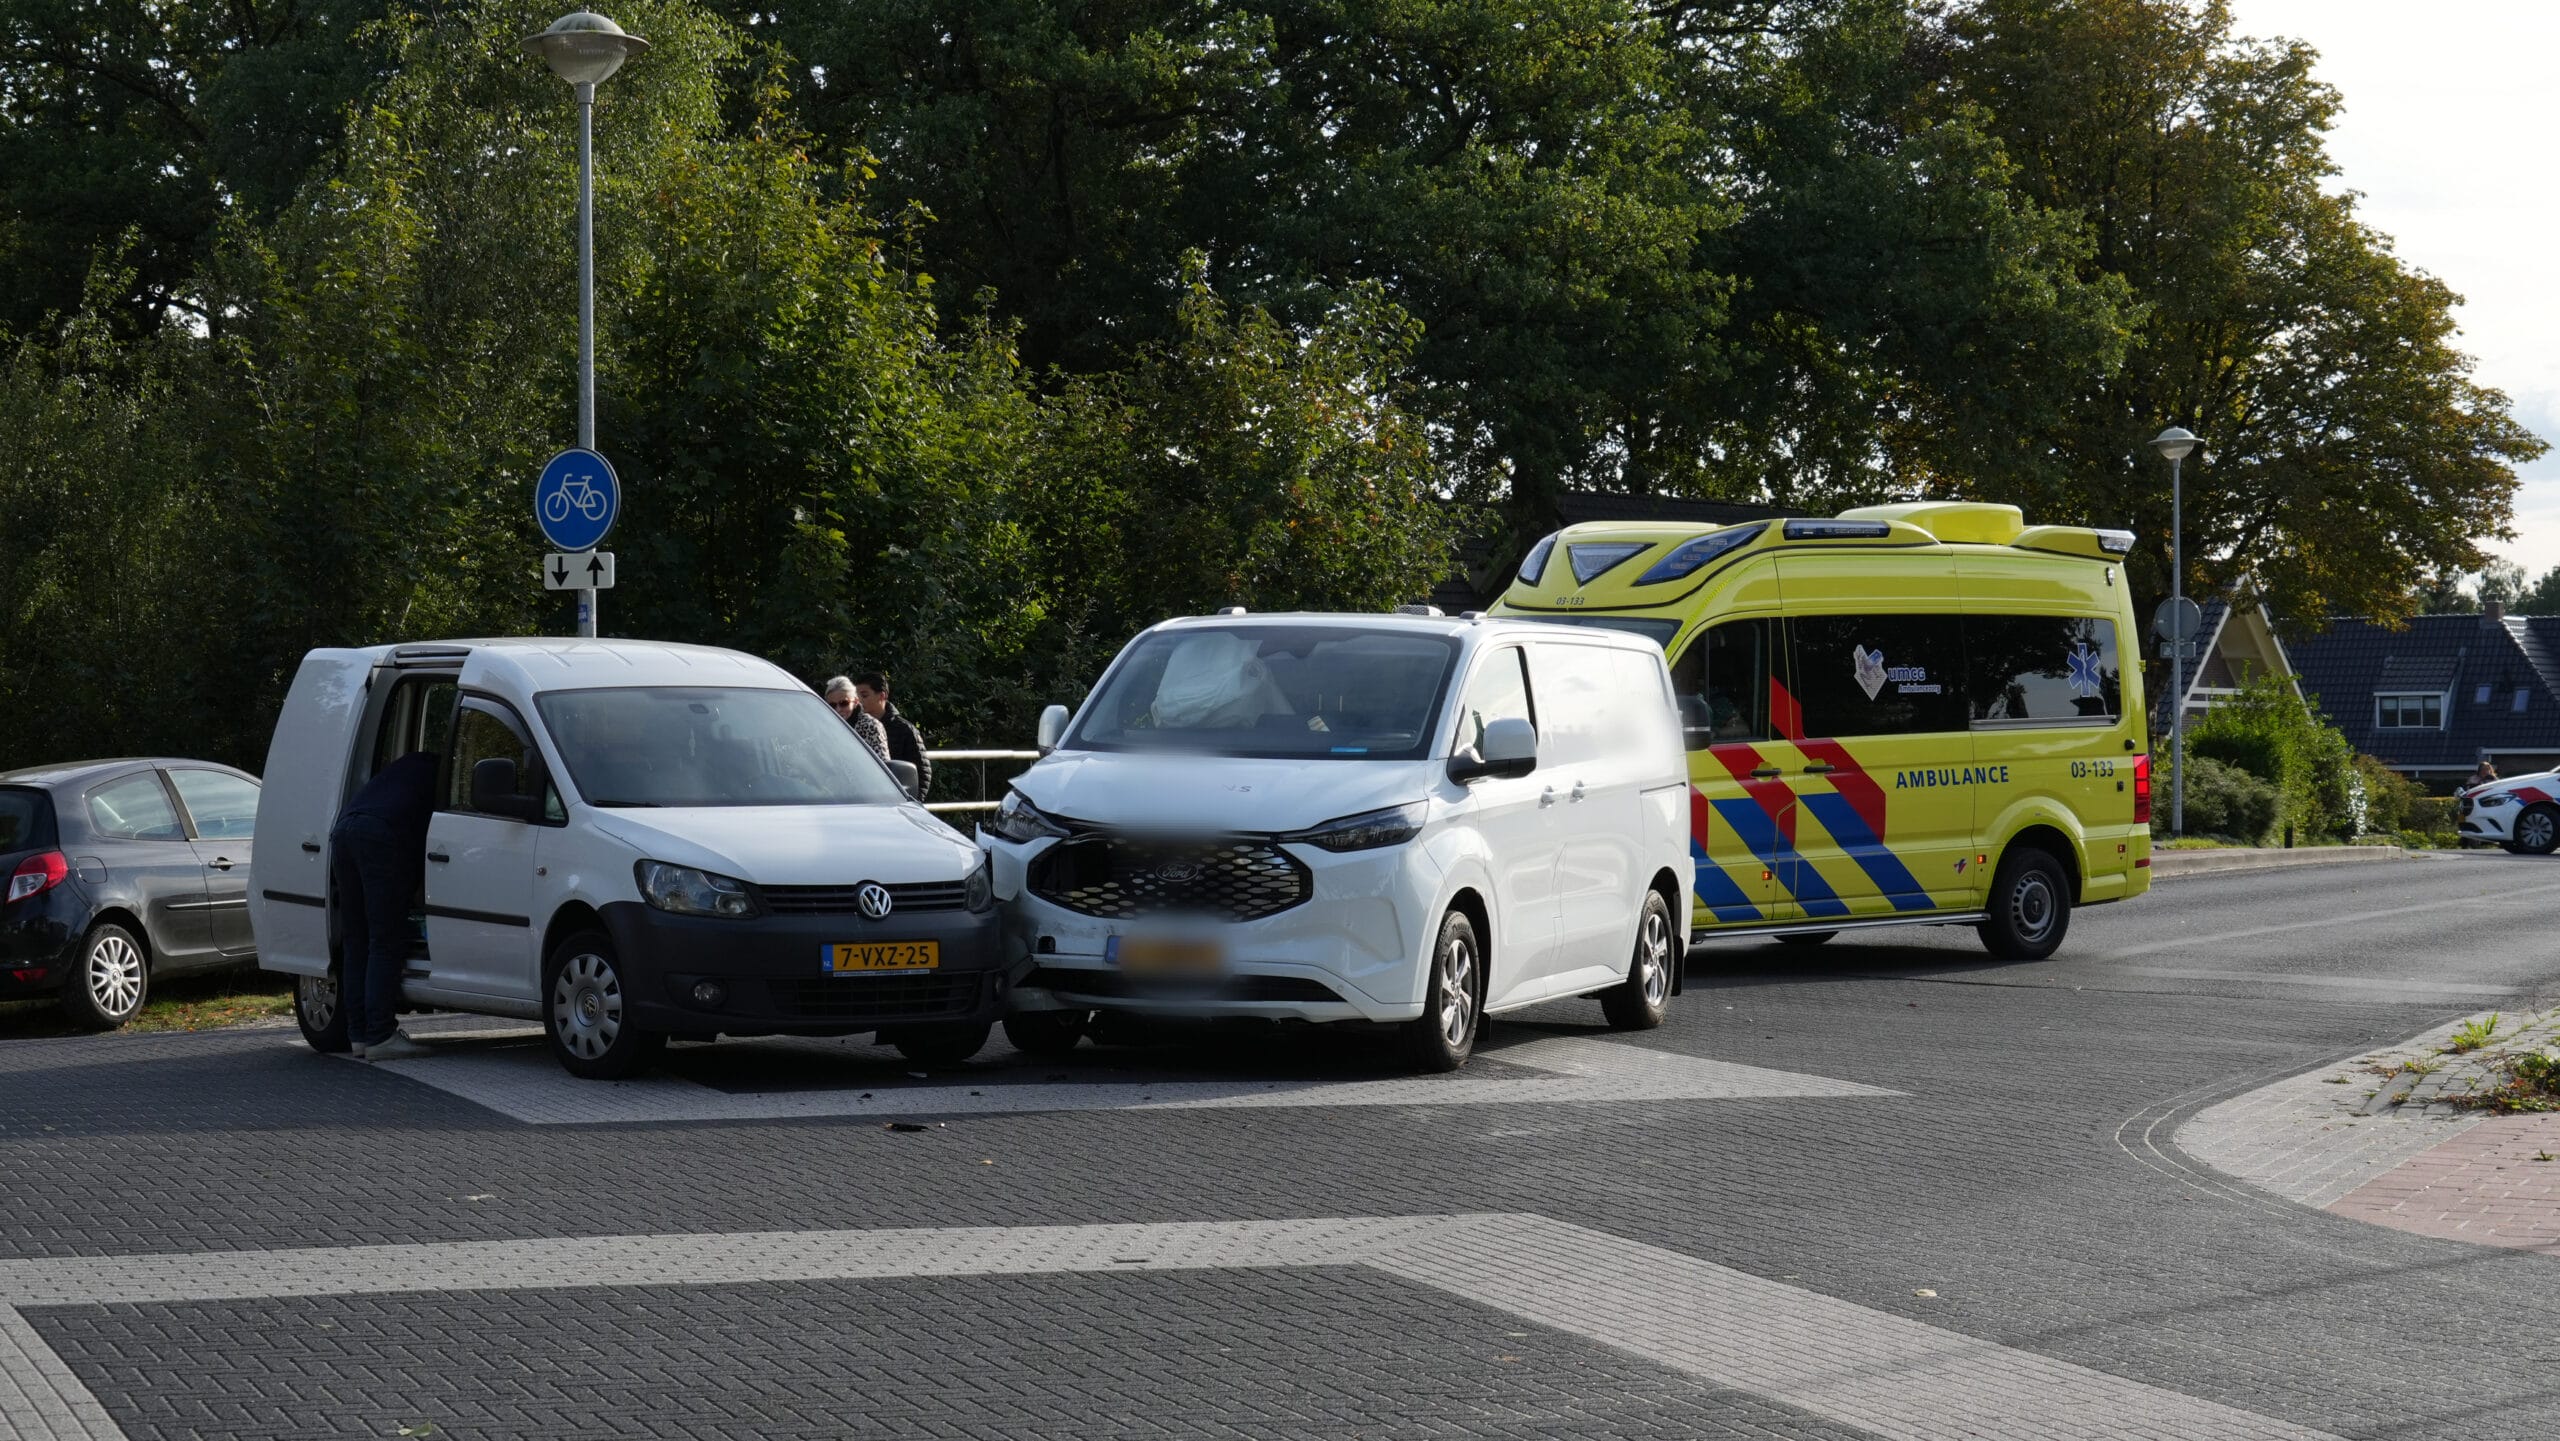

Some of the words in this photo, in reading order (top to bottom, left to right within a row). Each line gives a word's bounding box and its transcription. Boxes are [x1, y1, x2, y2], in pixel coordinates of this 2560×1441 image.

[1556, 596, 1585, 606] 03-133
[1895, 765, 2010, 789] AMBULANCE
[2070, 761, 2115, 778] 03-133
[841, 945, 931, 968] 7-VXZ-25
